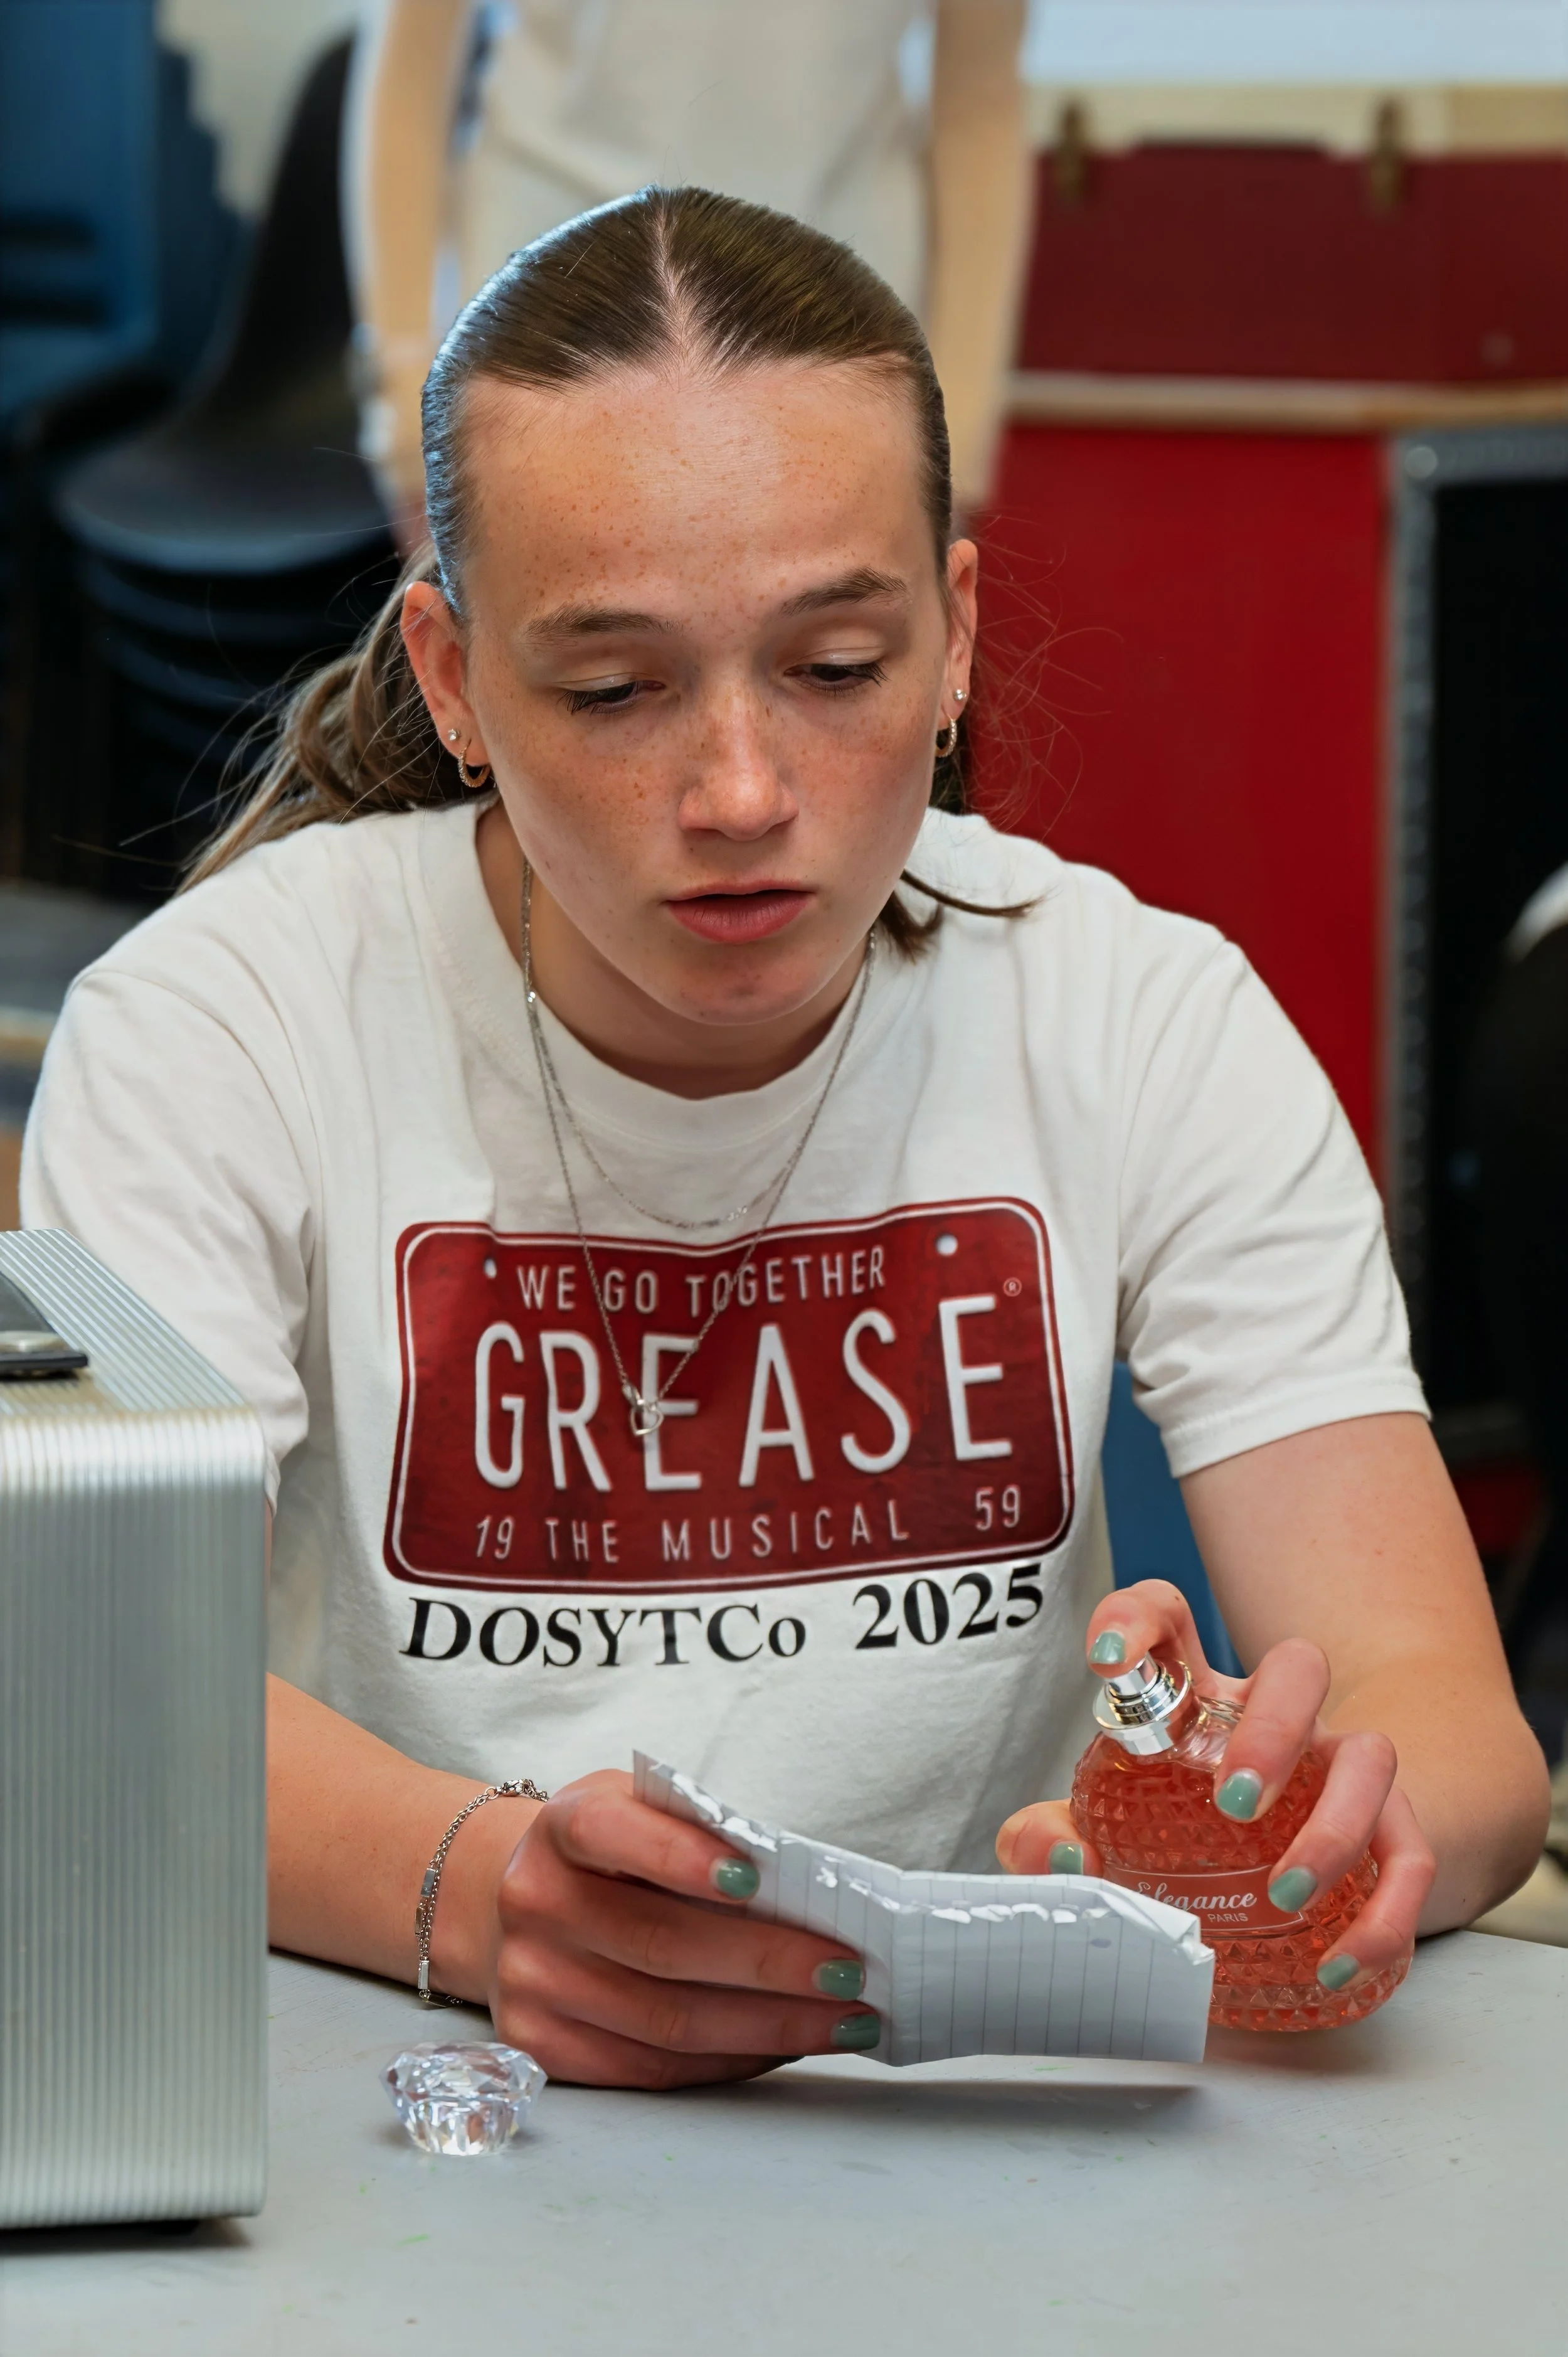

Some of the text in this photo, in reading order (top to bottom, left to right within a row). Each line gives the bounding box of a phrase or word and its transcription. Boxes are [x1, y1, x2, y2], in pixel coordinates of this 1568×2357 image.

[517, 1245, 886, 1318] WE GO TOGETHER
[474, 1295, 1012, 1491] GREASE
[475, 1485, 1022, 1563] 19 THE MUSICAL 59
[398, 1563, 1044, 1668] DOSYTCo 2025
[1207, 1912, 1249, 1922] PARIS
